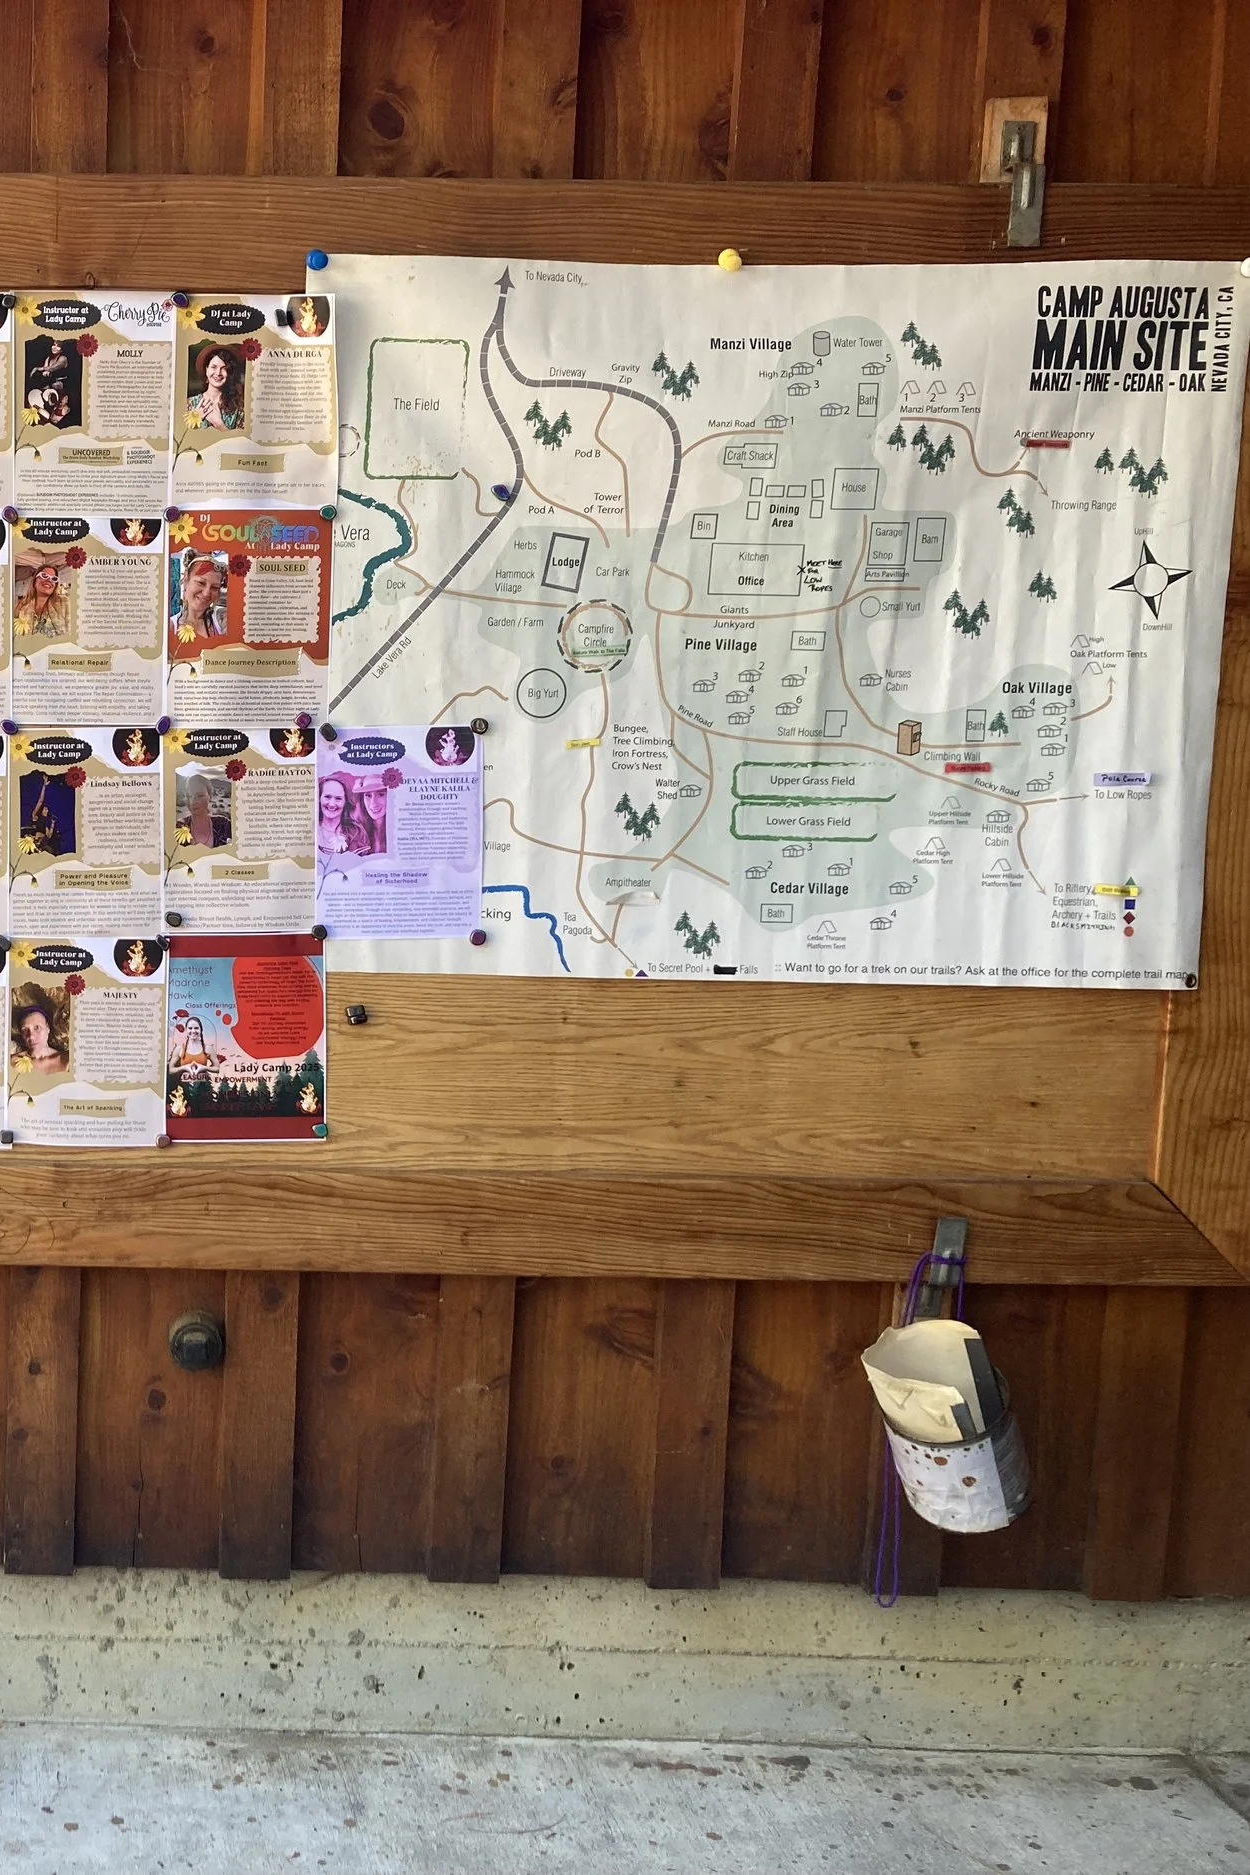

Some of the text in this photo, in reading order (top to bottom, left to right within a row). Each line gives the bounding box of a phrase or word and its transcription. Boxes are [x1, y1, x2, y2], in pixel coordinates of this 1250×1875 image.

[525, 271, 582, 284] To Nevada City
[1038, 286, 1209, 318] CAMP AUGUSTA
[43, 306, 81, 314] Instructor
[211, 310, 251, 319] DJ at Lady
[46, 314, 86, 325] Lady Camp
[219, 319, 242, 327] Camp
[833, 337, 882, 347] Water Tower
[1212, 287, 1234, 391] NEVADA CITY, CA
[710, 338, 792, 352] Manzi Village
[1032, 319, 1209, 370] MAIN SITE
[117, 350, 143, 358] MOLLY
[550, 368, 586, 379] Driveway
[612, 363, 640, 374] Gravity
[619, 375, 632, 384] Zip
[1030, 373, 1206, 392] MANZI PINE CEDAR OAK
[394, 398, 439, 411] The Field
[901, 405, 981, 414] Manzi Platform Tents
[1014, 429, 1094, 440] Ancient Weaponry
[575, 449, 601, 458] Pod B
[727, 450, 773, 461] Craft Snack
[842, 482, 866, 493] House
[770, 504, 800, 516] Dining
[1051, 501, 1116, 511] Throwing Range
[772, 517, 793, 528] Area
[341, 525, 369, 541] Vera
[739, 552, 769, 561] Kitchen
[90, 558, 151, 566] AMBER YOUNG
[552, 557, 579, 568] Lodge
[259, 564, 305, 572] SOUL SEED
[496, 570, 535, 579] Hammock
[386, 580, 406, 589] Deck
[738, 576, 764, 586] Office
[495, 583, 522, 593] Village
[720, 605, 749, 614] Giants
[882, 602, 920, 611] Small Yurt
[578, 624, 614, 635] Campfire
[713, 620, 754, 630] Junkyard
[584, 636, 607, 647] Circle
[685, 638, 757, 652] Pine Village
[205, 658, 296, 668] Dance Journey Description
[528, 688, 558, 699] Big Yurt
[1002, 682, 1072, 695] Oak Village
[614, 724, 648, 735] Bungee,
[613, 737, 675, 747] Tree Climbing,
[612, 749, 668, 759] Iron Fortress,
[924, 752, 980, 761] Climbing Wall
[612, 762, 662, 770] Crow's Nest
[90, 780, 121, 789] Lindsay
[770, 776, 855, 786] Upper Grass Field
[766, 816, 850, 826] Lower Grass Field
[606, 877, 651, 888] Ampitheater
[770, 882, 849, 895] Cedar Village
[785, 963, 811, 973] Want
[815, 964, 824, 973] to
[828, 966, 840, 975] go
[844, 964, 857, 973] for
[871, 964, 890, 973] trek
[894, 966, 908, 974] on
[910, 966, 926, 974] our
[932, 965, 961, 975] trails?
[965, 965, 985, 975] Ask
[989, 966, 999, 975] at
[1002, 967, 1018, 976] the
[1021, 967, 1050, 976] office
[1055, 968, 1068, 977] for
[1072, 968, 1088, 977] the
[1092, 969, 1140, 980] complete
[1144, 969, 1162, 978] trail
[204, 1002, 236, 1010] Offerings
[234, 1063, 319, 1074] Lady Camp 2025
